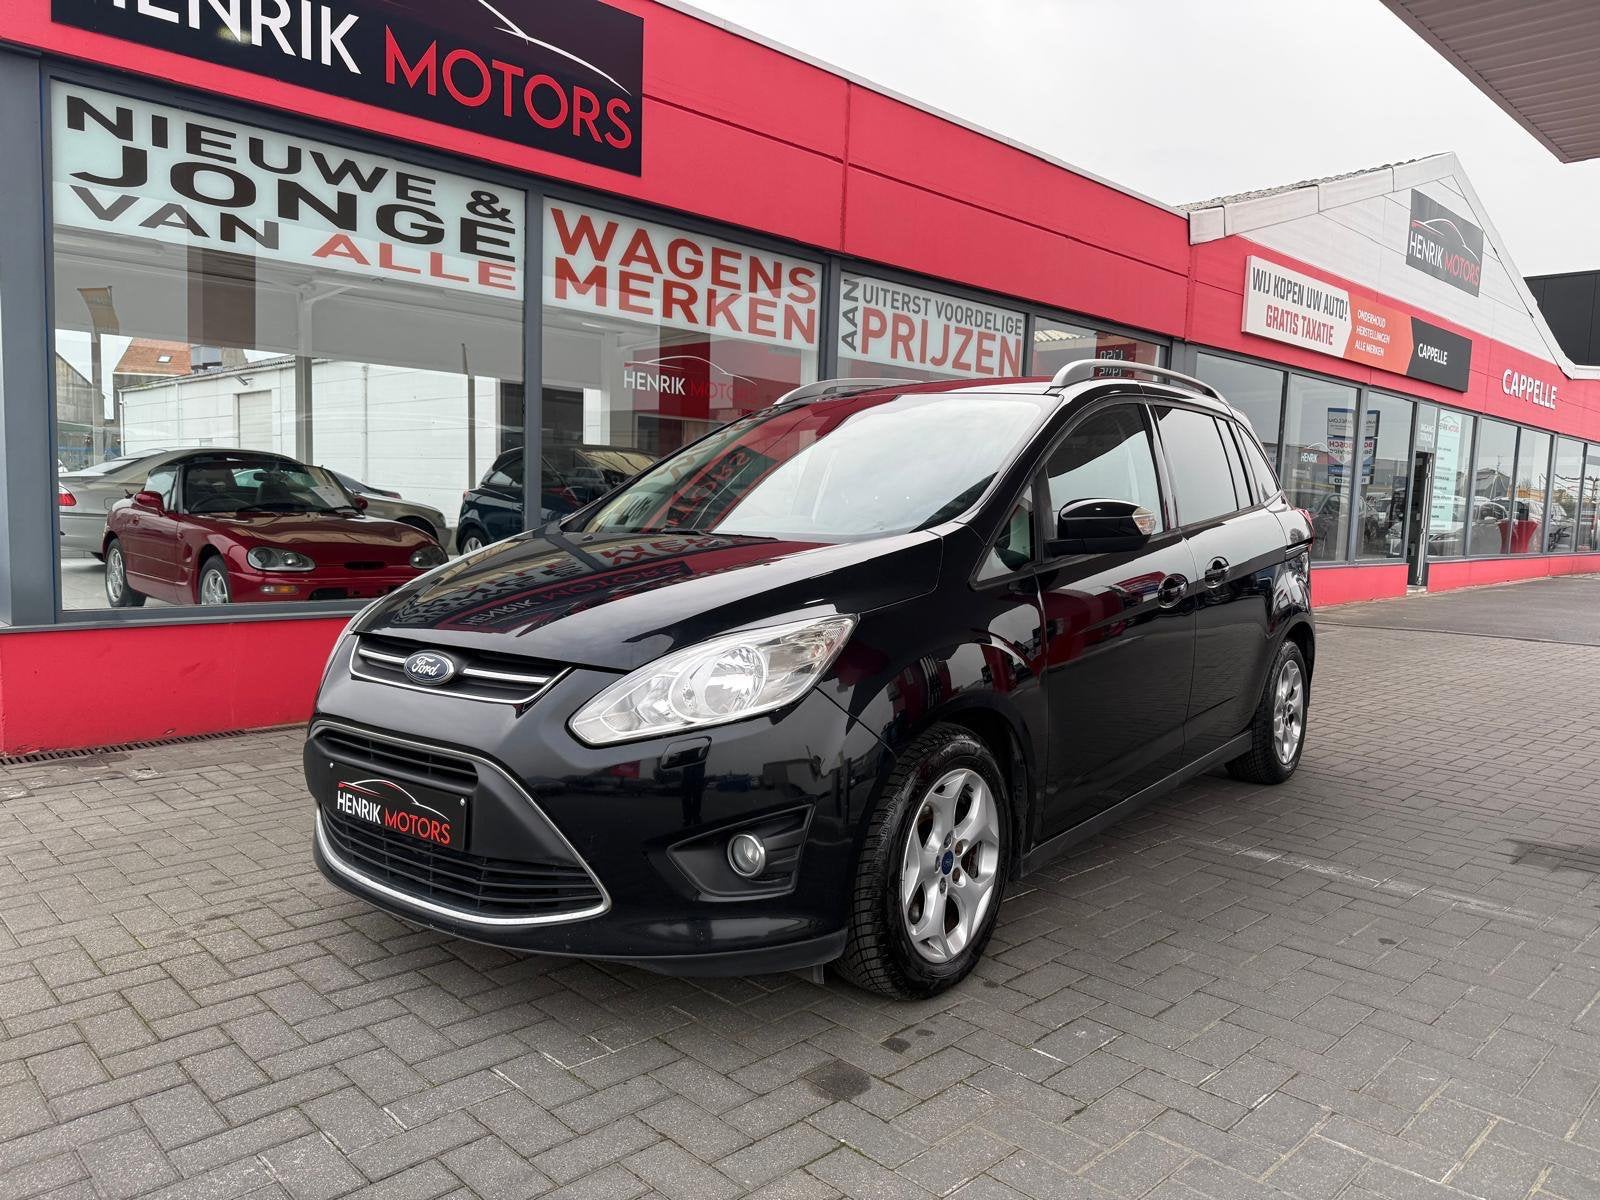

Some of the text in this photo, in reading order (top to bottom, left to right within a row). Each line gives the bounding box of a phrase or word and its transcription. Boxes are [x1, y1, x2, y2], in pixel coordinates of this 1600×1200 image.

[112, 0, 633, 150] NRIK MOTORS
[66, 94, 512, 224] NIEUWE &
[69, 144, 516, 262] JONGE
[69, 185, 517, 291] VAN ALLE
[550, 207, 818, 305] WAGENS
[1408, 230, 1480, 286] HENRIK MOTORS
[553, 256, 817, 345] MERKEN
[841, 278, 860, 352] AAN
[863, 283, 1023, 337] UITERST VOORDELIGE
[1252, 267, 1348, 322] WIJ KOPEN UW AUTO!
[1357, 309, 1386, 328] ONDERHOUD
[861, 306, 1022, 377] PRIJZEN
[1265, 304, 1334, 346] GRATIS TAXATIE
[1354, 340, 1385, 357] ALLE MERKEN
[1356, 325, 1391, 345] HERSTELLINGEN
[1417, 343, 1448, 365] CAPPELLE
[624, 371, 757, 404] HENRIK MOTO
[1502, 368, 1558, 410] CAPPELLE
[411, 656, 440, 676] Ford
[337, 790, 451, 845] HENRIK MOTORS
